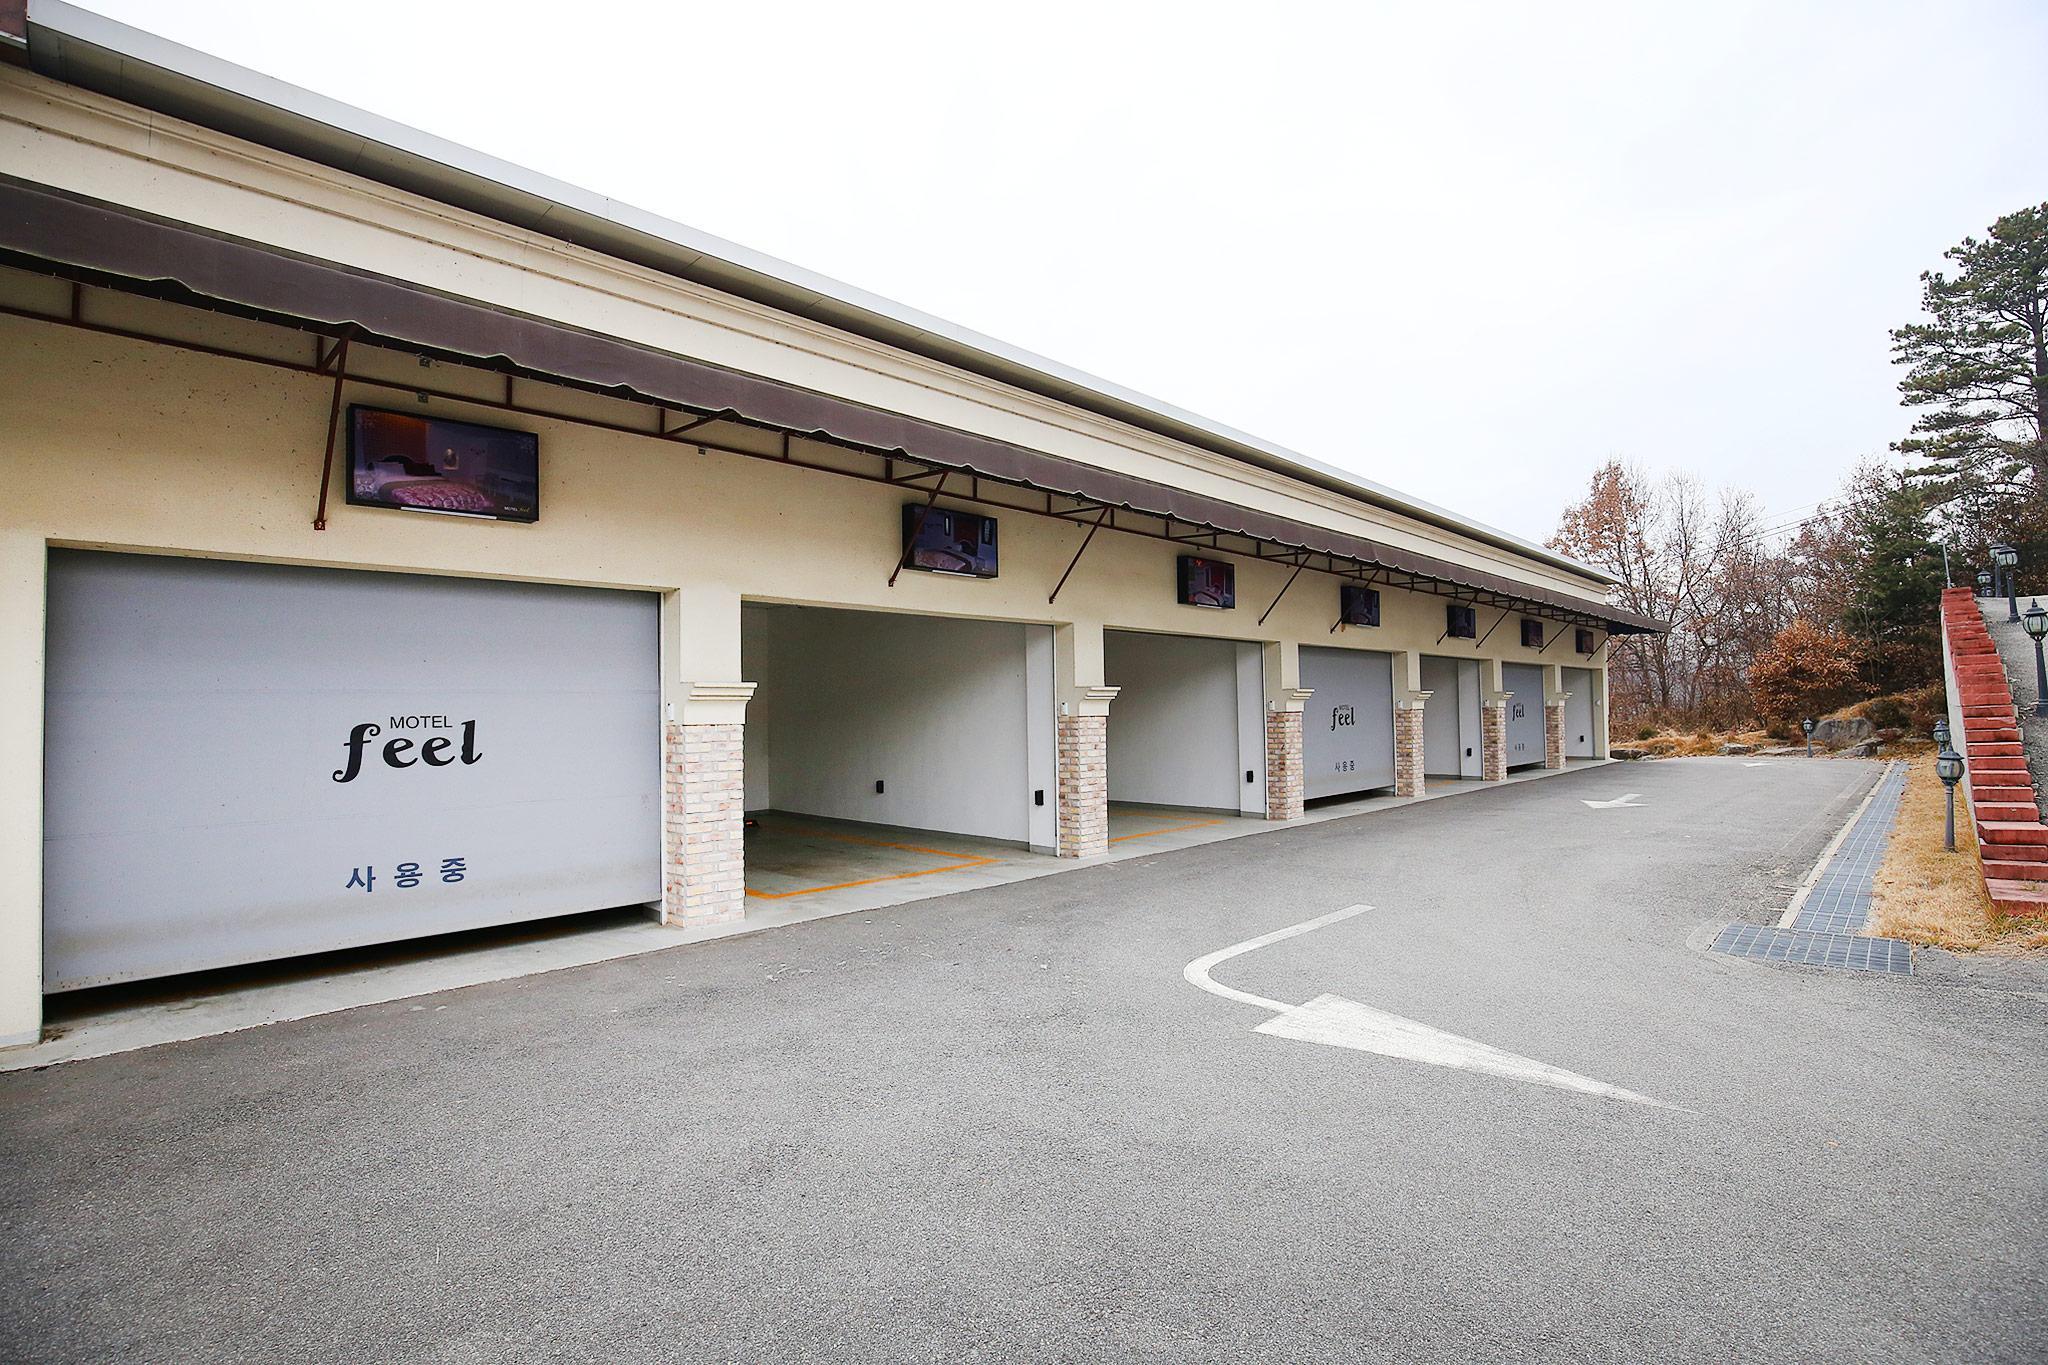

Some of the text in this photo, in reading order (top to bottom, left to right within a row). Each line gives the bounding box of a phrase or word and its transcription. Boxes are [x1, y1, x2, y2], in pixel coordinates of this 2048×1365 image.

[390, 715, 453, 729] MOTEL
[1331, 707, 1355, 731] feel
[332, 719, 483, 783] feel
[346, 857, 467, 893] 사용중
